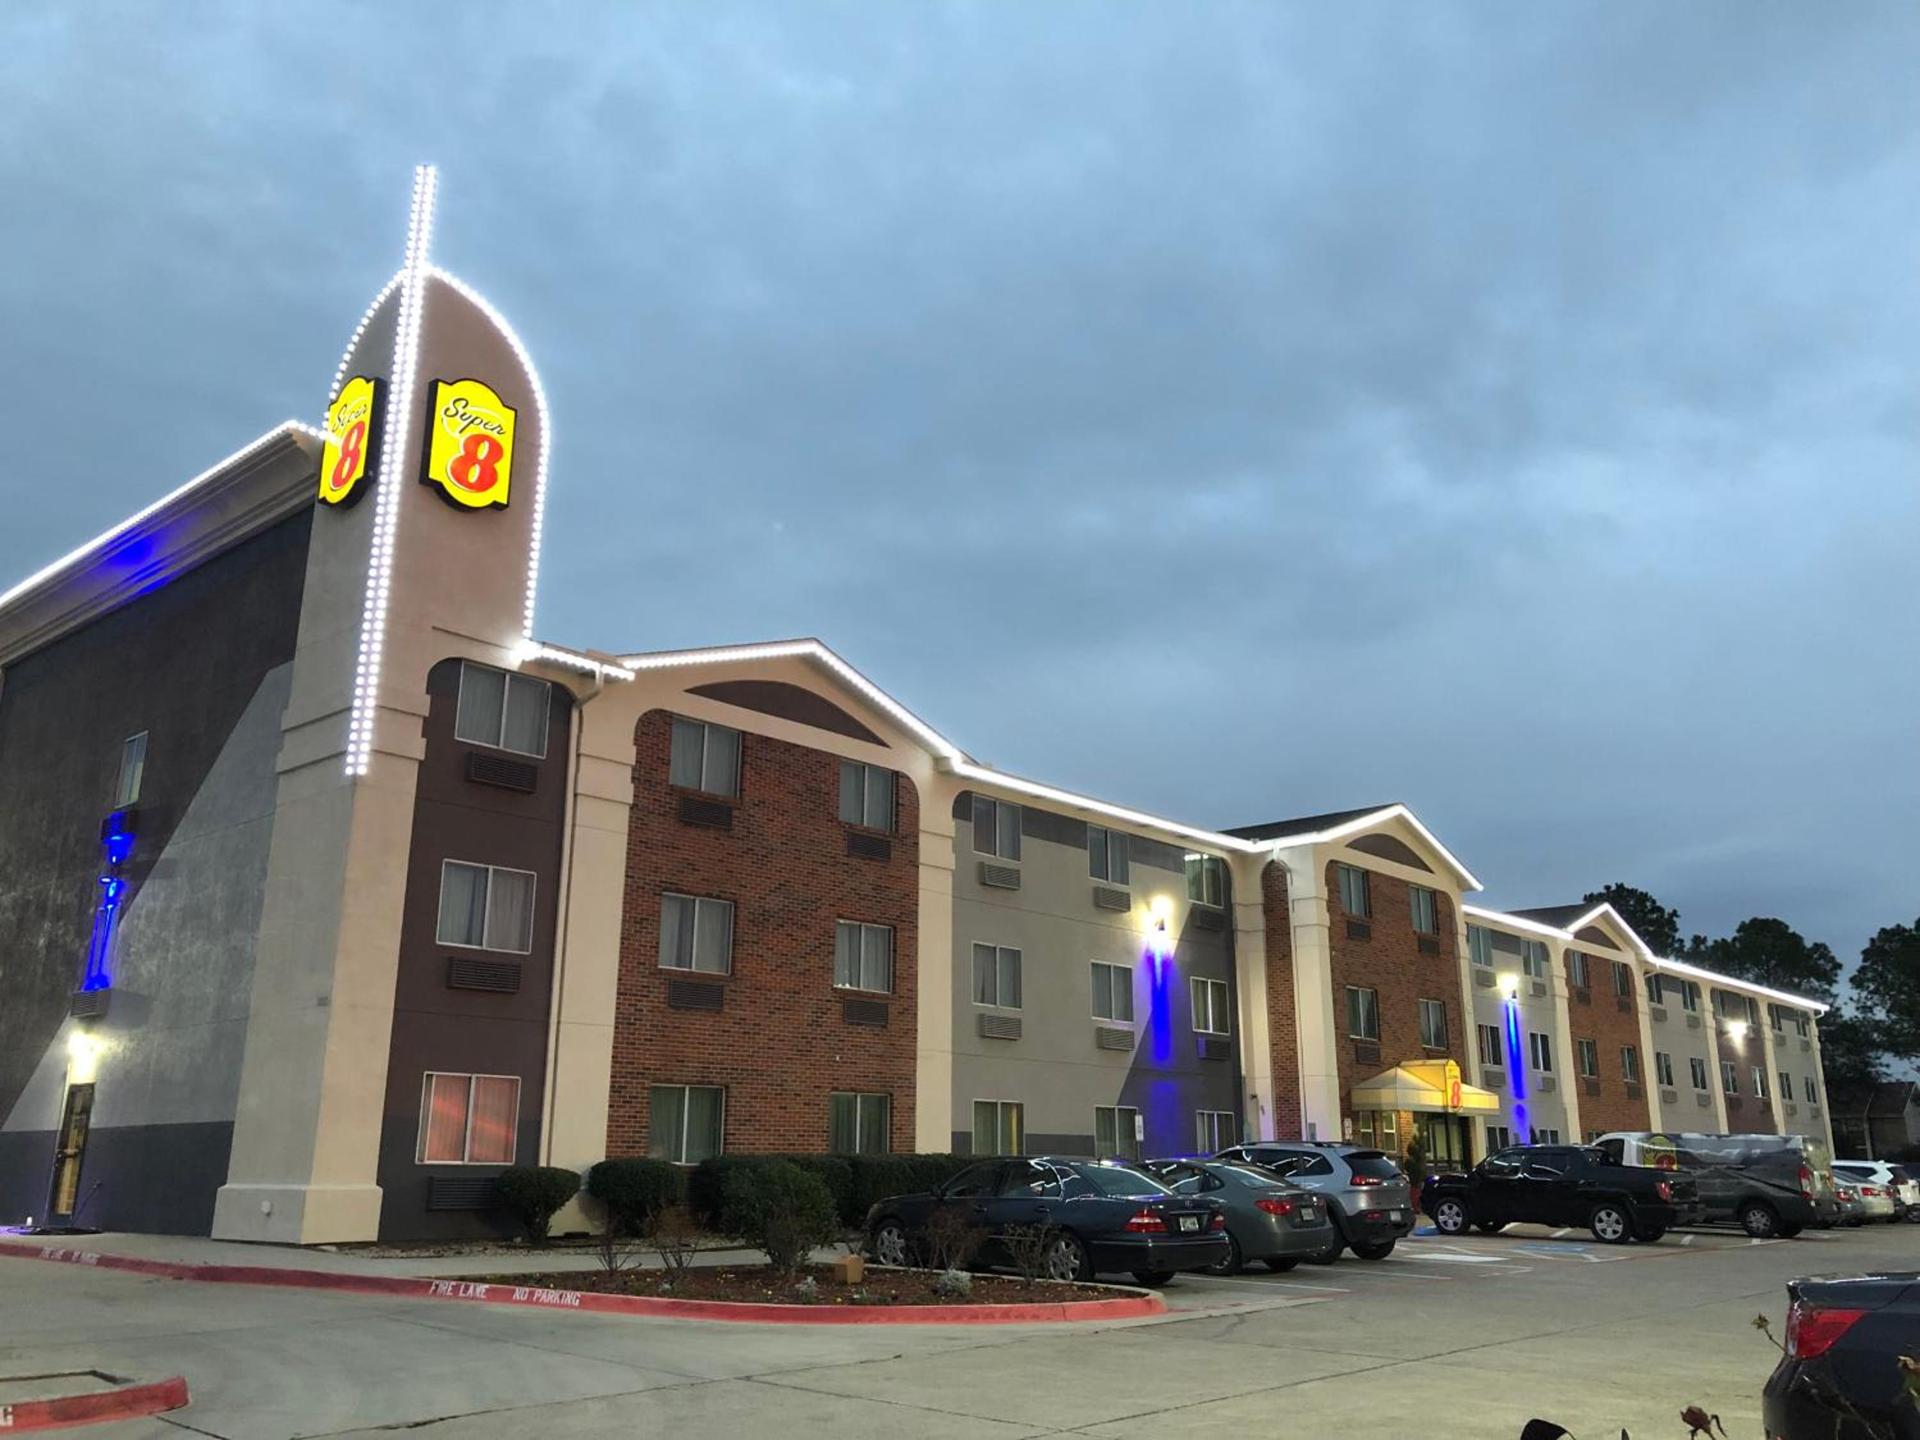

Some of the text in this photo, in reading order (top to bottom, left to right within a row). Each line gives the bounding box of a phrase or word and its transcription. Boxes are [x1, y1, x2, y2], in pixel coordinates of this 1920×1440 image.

[442, 397, 507, 435] Super
[331, 420, 366, 490] 8
[448, 433, 504, 493] 8
[429, 1280, 490, 1299] FIRE LANE
[512, 1287, 582, 1307] NO PARKING
